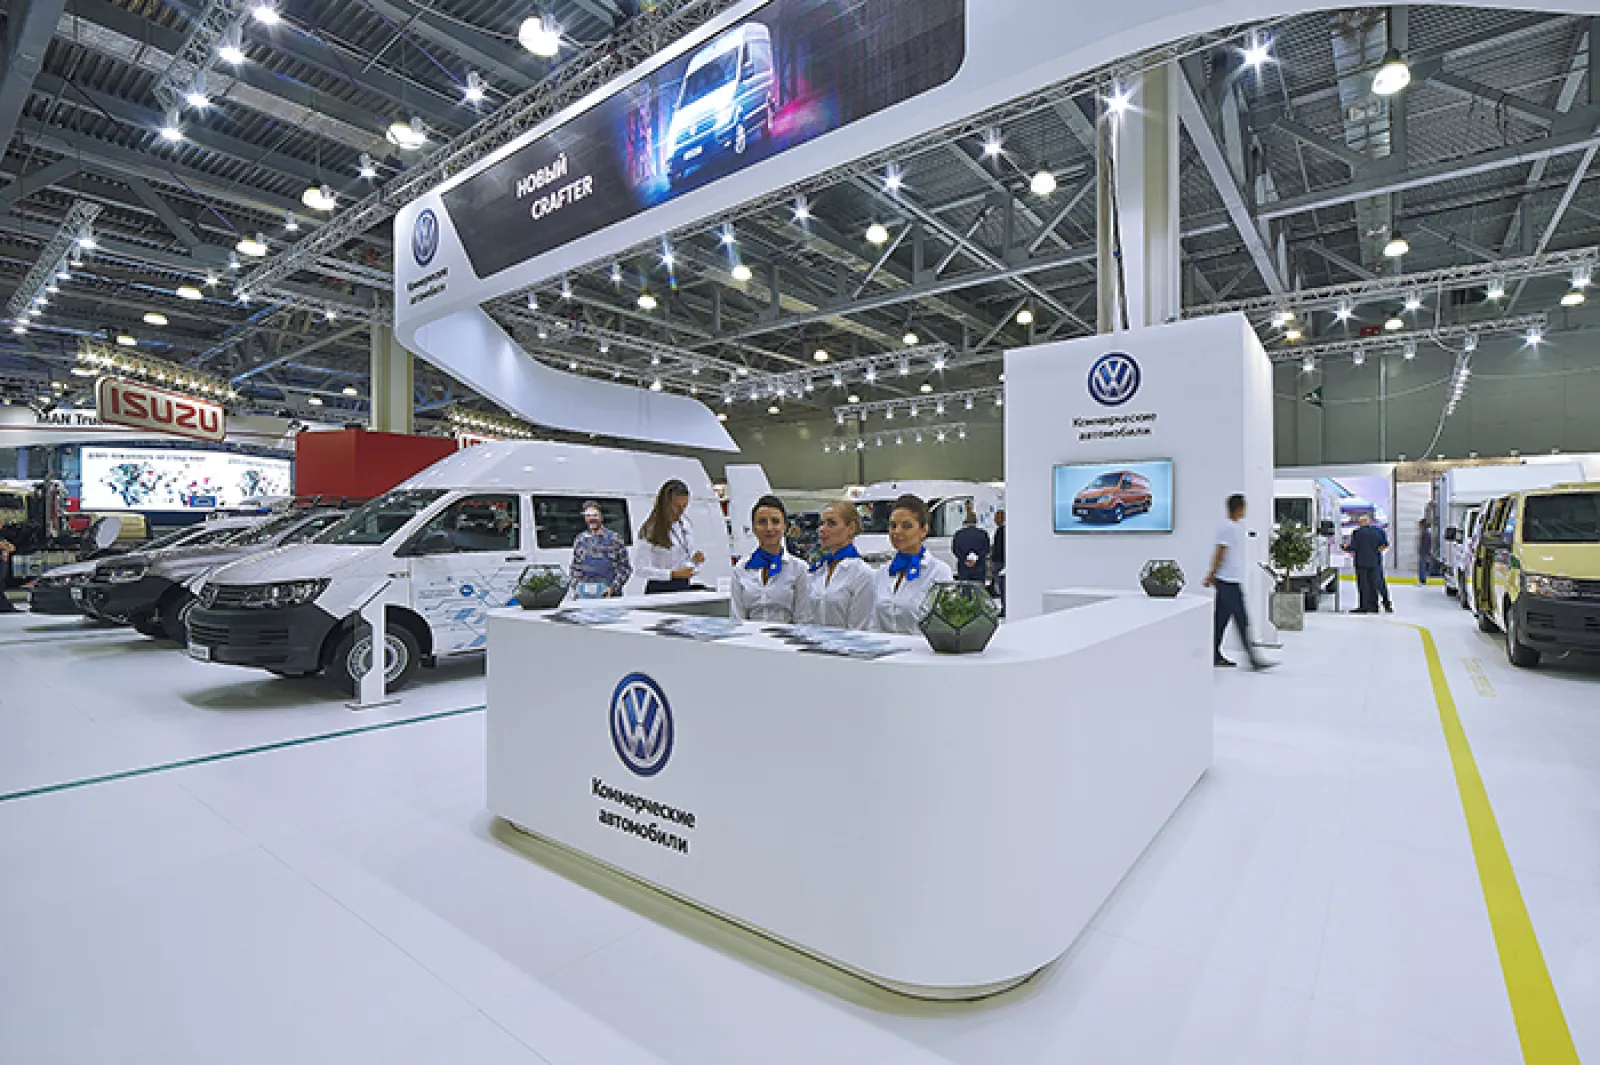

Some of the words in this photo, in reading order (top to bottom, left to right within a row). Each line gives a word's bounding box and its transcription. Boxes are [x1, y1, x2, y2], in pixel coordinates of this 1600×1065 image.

[516, 152, 568, 198] НОВЫЙ
[530, 175, 594, 220] CRAFTER
[111, 387, 218, 433] ISUZU
[591, 776, 696, 828] Коммерческие
[599, 808, 689, 854] автомобили
